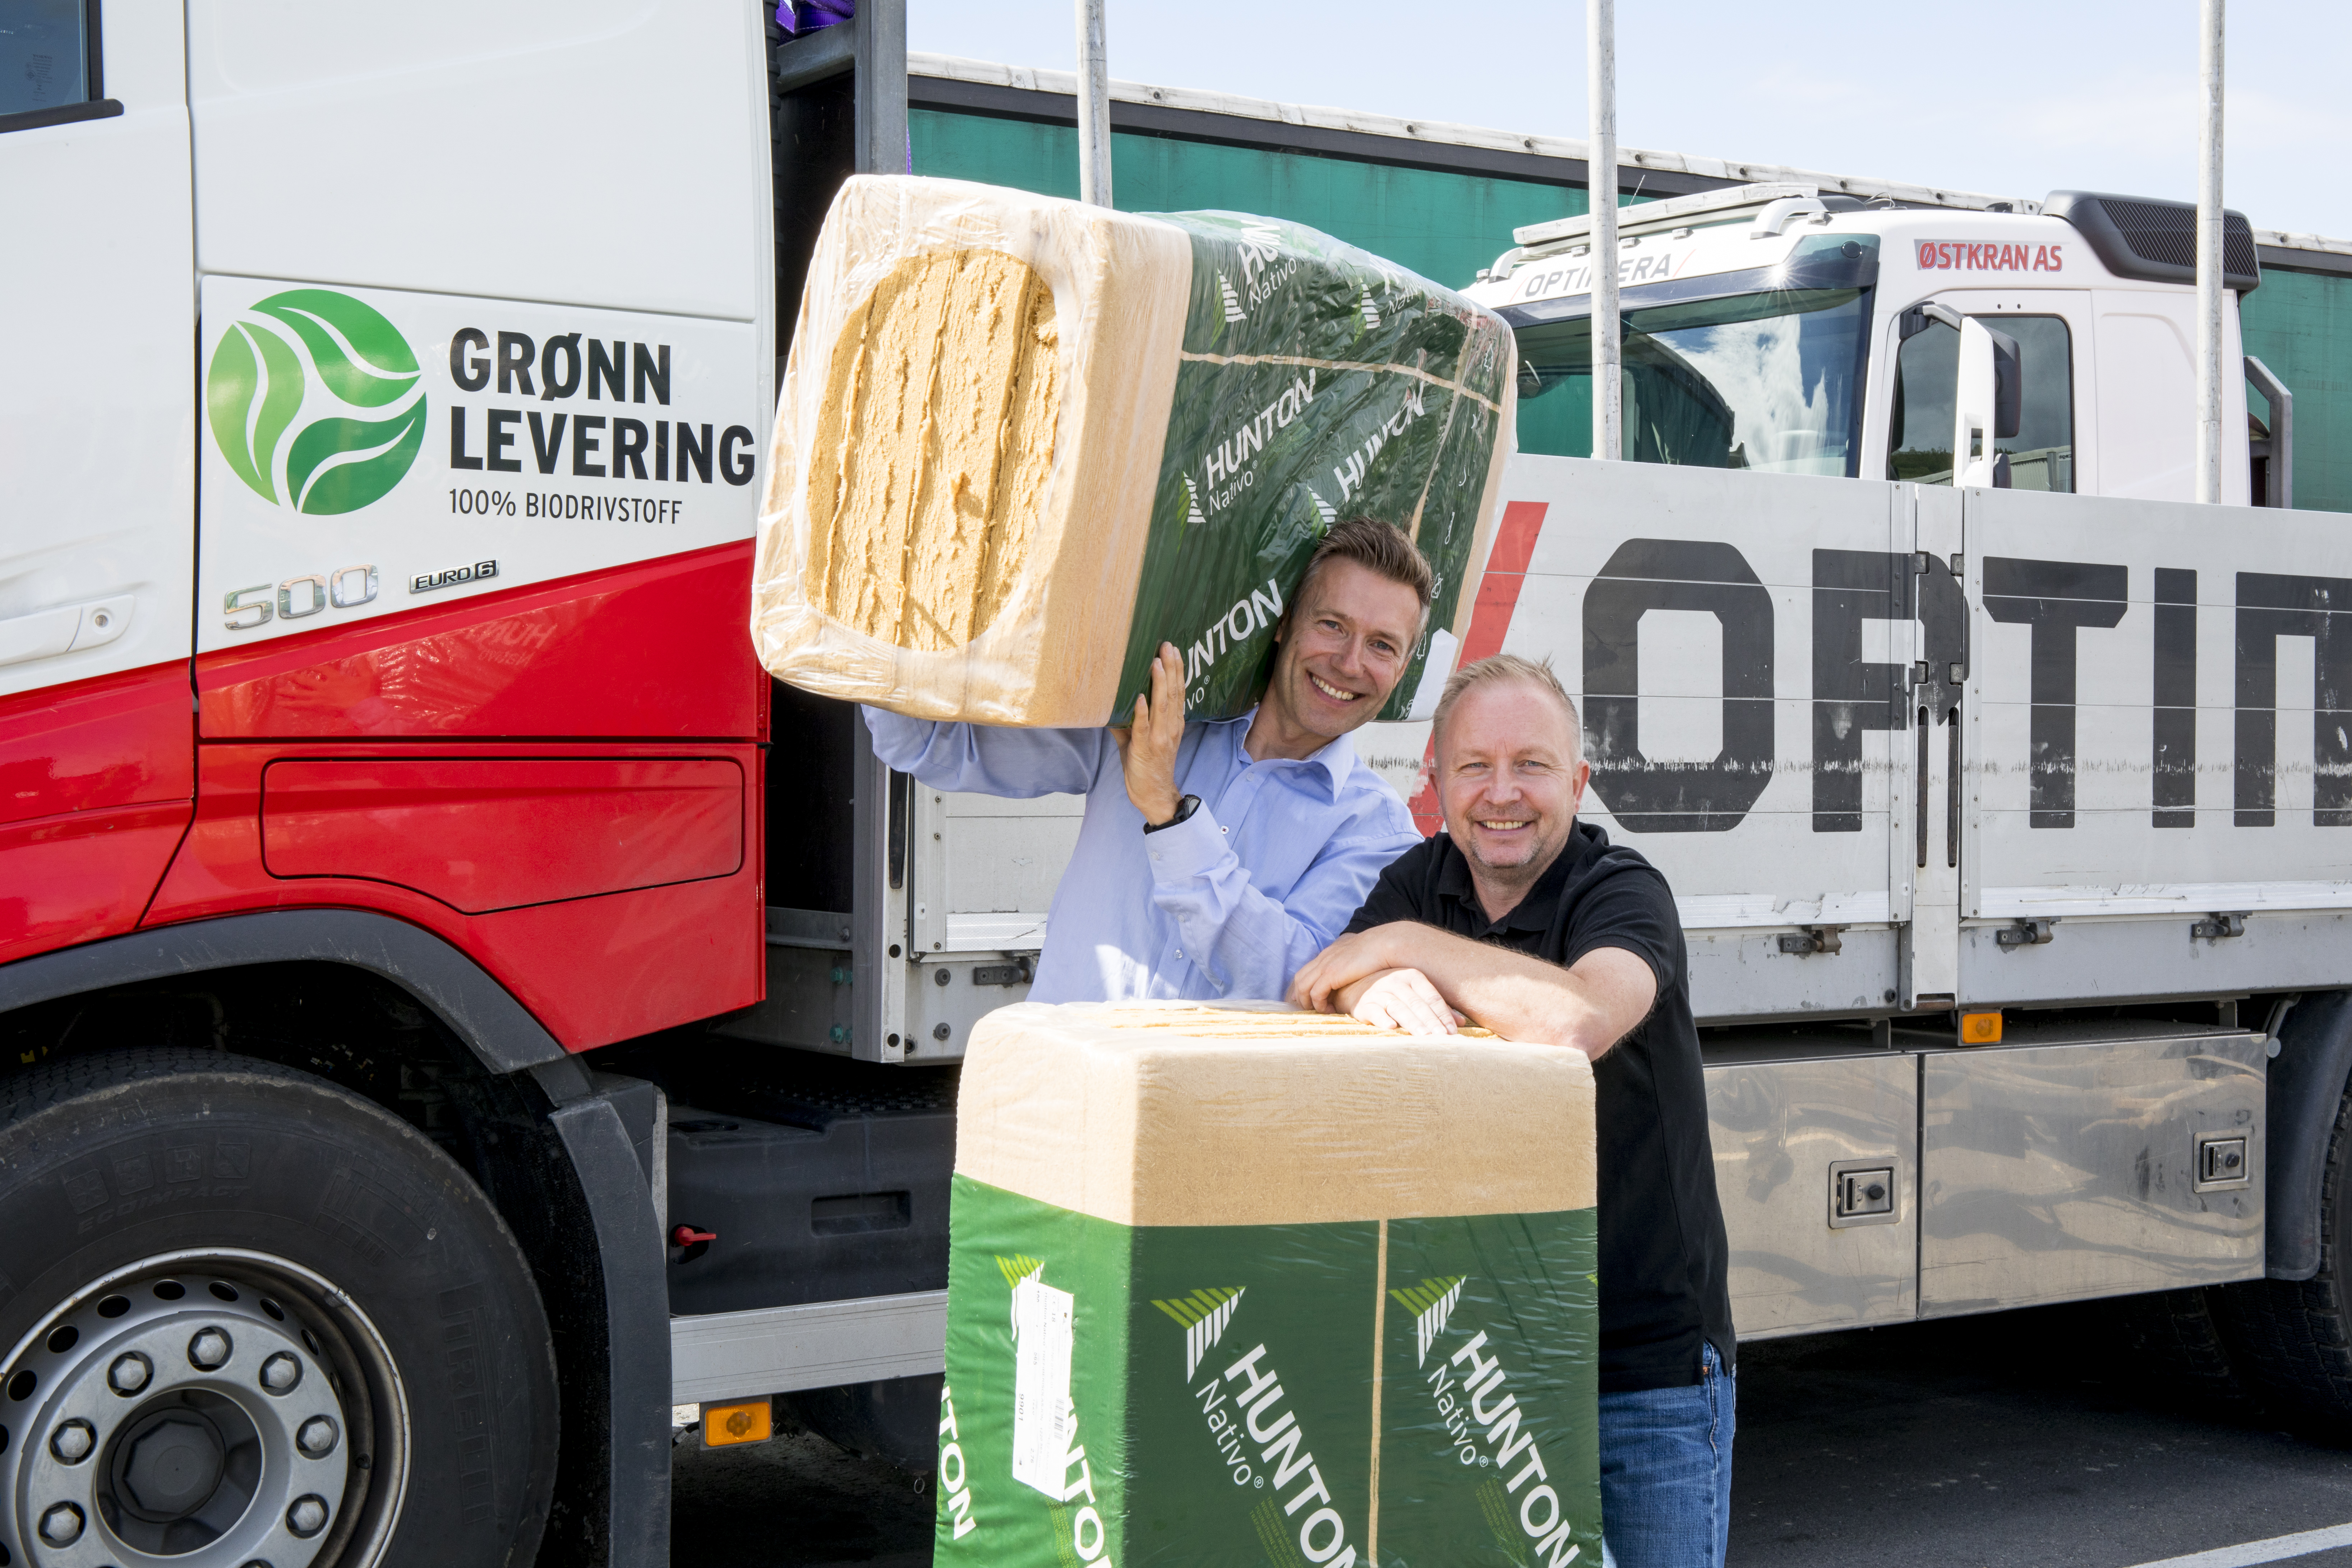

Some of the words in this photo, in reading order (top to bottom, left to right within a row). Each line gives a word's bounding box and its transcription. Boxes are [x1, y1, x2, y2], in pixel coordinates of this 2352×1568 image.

[1250, 258, 1297, 311] Nativo
[1525, 254, 1671, 297] OPTIERA
[1919, 242, 2029, 271] ØSTKRAN
[2033, 245, 2062, 271] AS
[1385, 277, 1422, 319] Nativo
[450, 327, 670, 406] GRØNN
[451, 406, 755, 486] LEVERING
[1205, 368, 1317, 490] HUNTON
[449, 489, 516, 516] 100%
[526, 493, 682, 524] BIODRIVSTOFF
[225, 563, 378, 630] 500
[1185, 578, 1283, 689] UNTON
[76, 1185, 252, 1235] ECOIMPACT
[438, 1281, 506, 1525] PIRELLI
[939, 1386, 976, 1540] TON
[1260, 1500, 1272, 1519] WOOD
[1268, 1519, 1280, 1537] FIBER
[1484, 1479, 1496, 1496] WOOD
[1492, 1496, 1503, 1514] FIBER
[1266, 1496, 1297, 1556] TREFIBERISOLASJON
